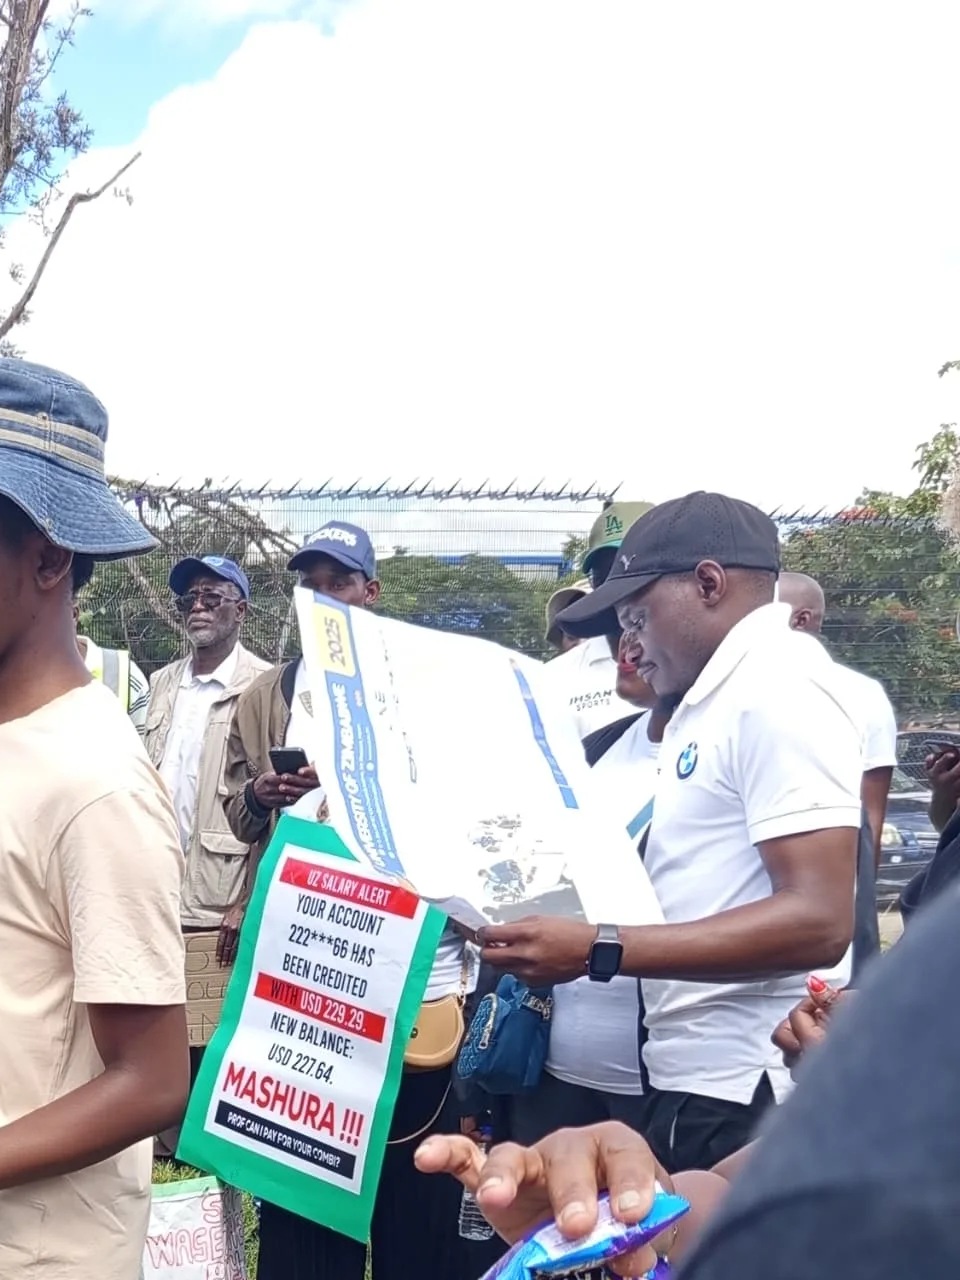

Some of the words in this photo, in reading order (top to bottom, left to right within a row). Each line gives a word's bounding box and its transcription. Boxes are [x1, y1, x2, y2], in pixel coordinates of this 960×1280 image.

[324, 616, 347, 667] 2025
[332, 683, 355, 772] ZIMBABWE
[342, 773, 359, 794] OF
[307, 869, 321, 886] UZ
[322, 875, 358, 897] SALARY
[357, 883, 391, 907] ALERT
[296, 893, 327, 920] YOUR
[327, 903, 386, 936] ACCOUNT
[282, 953, 310, 980] BEEN
[312, 961, 368, 999] CREDITED
[350, 942, 375, 967] HAS
[270, 980, 298, 1006] WITH
[300, 990, 322, 1015] USD
[323, 999, 366, 1033] 229.29.
[270, 1011, 298, 1037] NEW
[298, 1022, 354, 1060] BALANCE:
[267, 1043, 293, 1066] USD
[291, 1052, 334, 1085] 227.64.
[222, 1061, 335, 1137] MASHURA
[227, 1111, 246, 1129] PROF
[245, 1119, 260, 1137] CAN
[262, 1126, 277, 1143] PAY
[277, 1132, 292, 1150] FOR
[292, 1139, 312, 1157] YOUR
[312, 1147, 341, 1168] COMBI?
